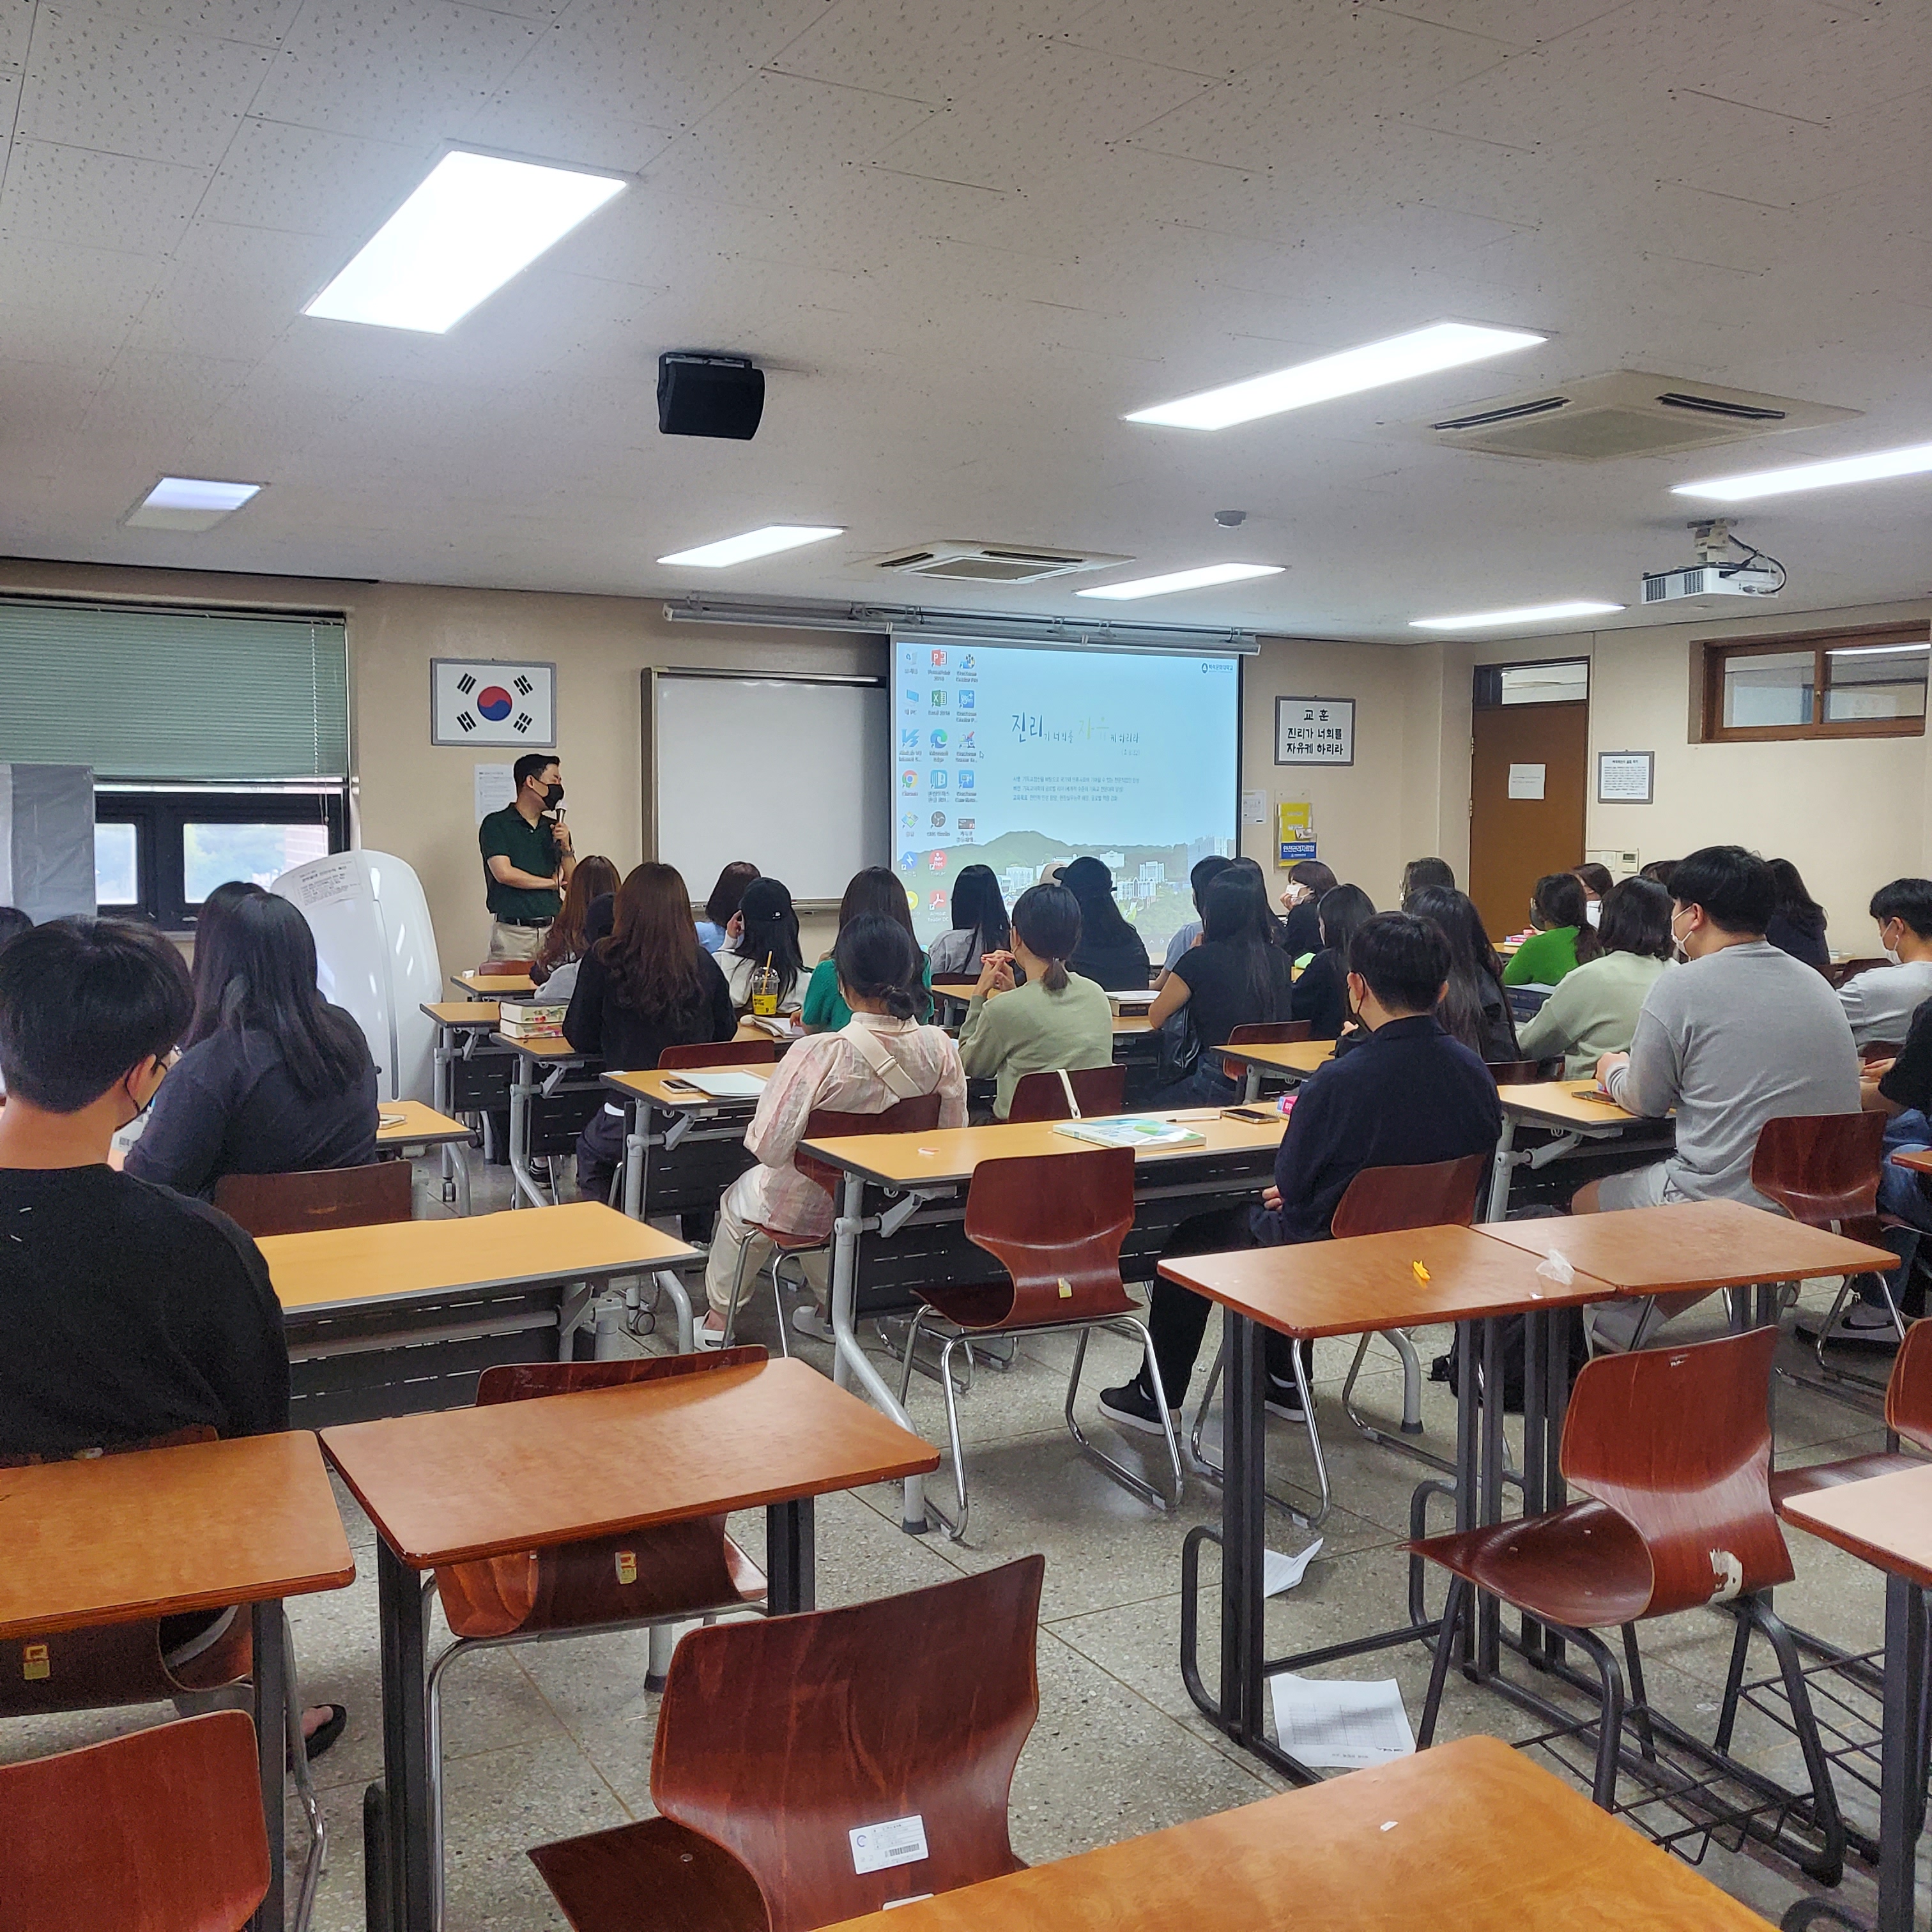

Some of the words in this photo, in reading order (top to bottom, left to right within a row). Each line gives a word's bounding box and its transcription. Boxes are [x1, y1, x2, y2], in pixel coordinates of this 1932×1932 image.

[1287, 727, 1314, 739] 진리가
[1317, 728, 1342, 740] 너희를
[1286, 742, 1314, 754] 자유케
[1317, 743, 1344, 756] 하리라
